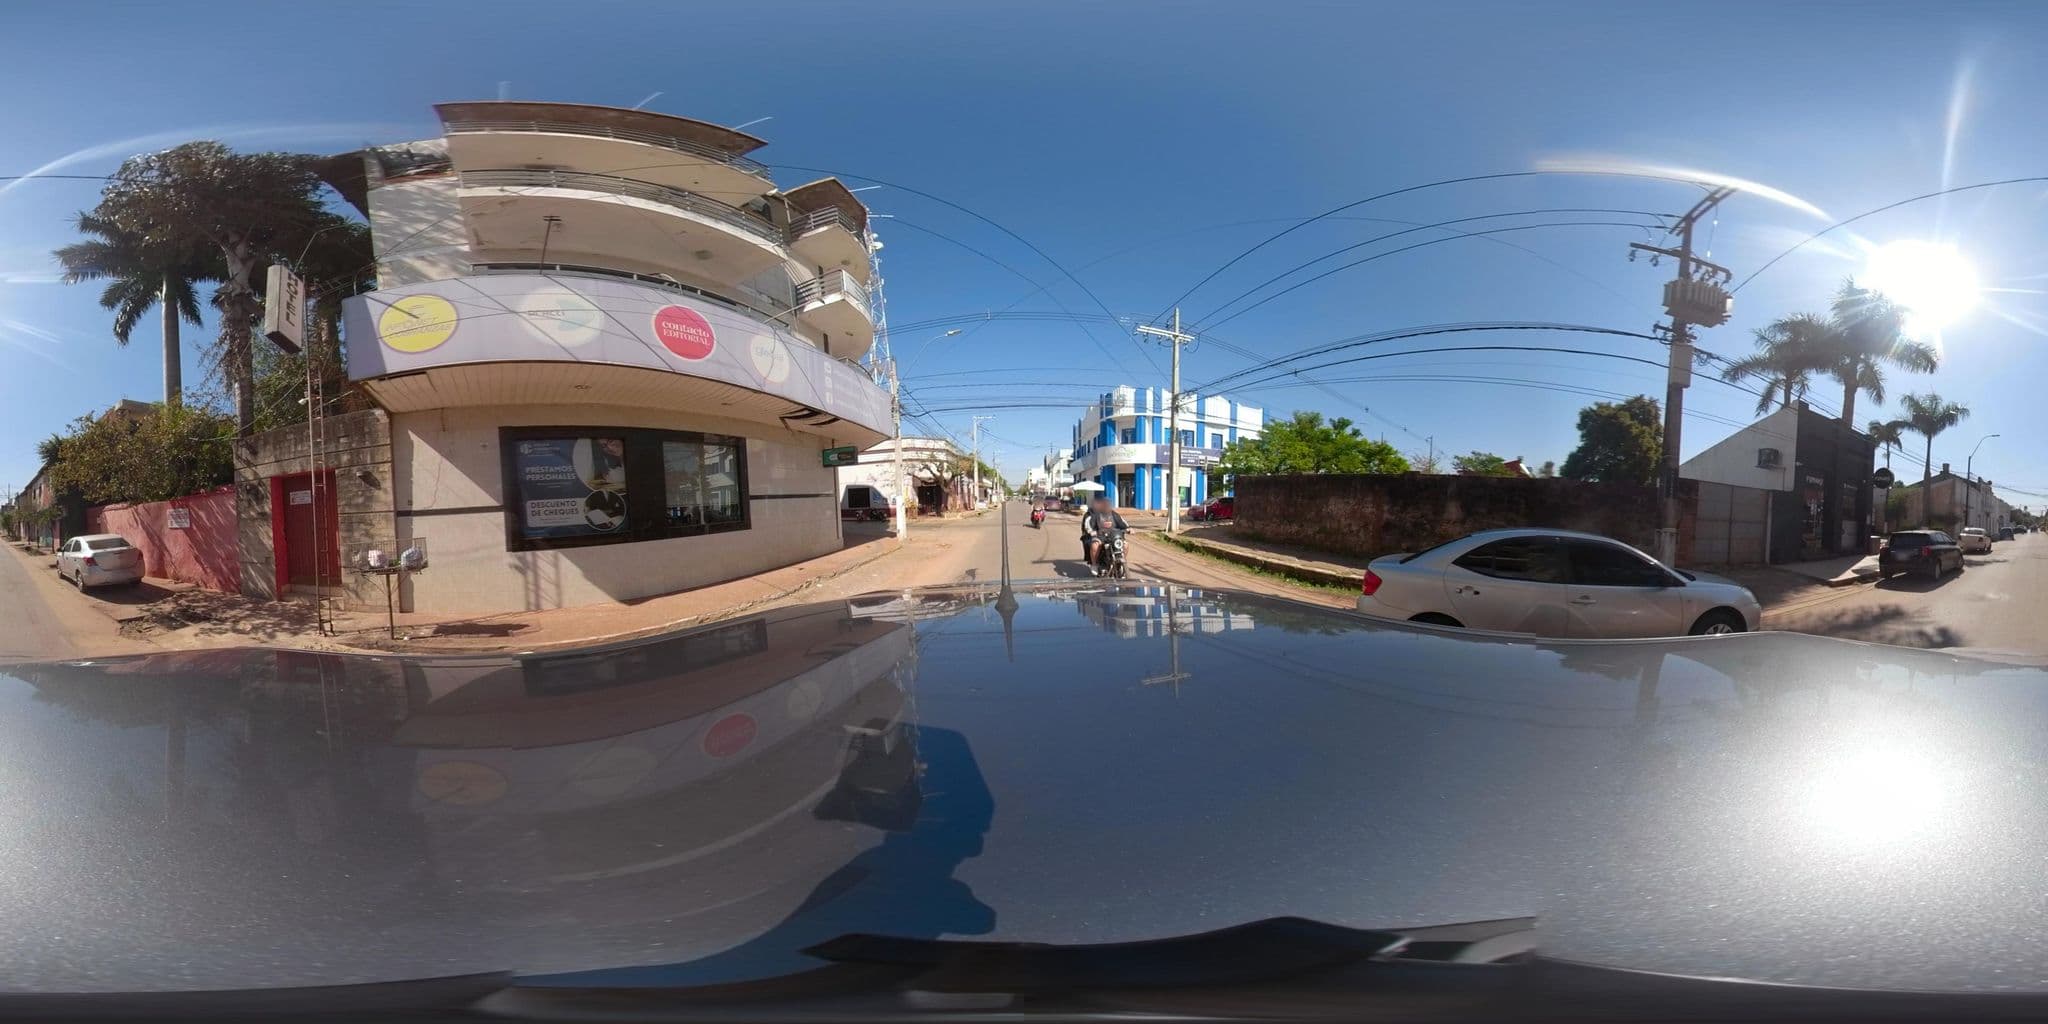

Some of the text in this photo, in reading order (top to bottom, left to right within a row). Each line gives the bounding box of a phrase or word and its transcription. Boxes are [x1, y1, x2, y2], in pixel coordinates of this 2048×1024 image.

[286, 272, 299, 327] HOTEL
[662, 320, 710, 338] contacto
[663, 328, 711, 346] EDITORIAL
[526, 473, 577, 481] PERSONALES
[530, 500, 577, 509] DESCUENTO
[543, 508, 579, 516] CHEQUES
